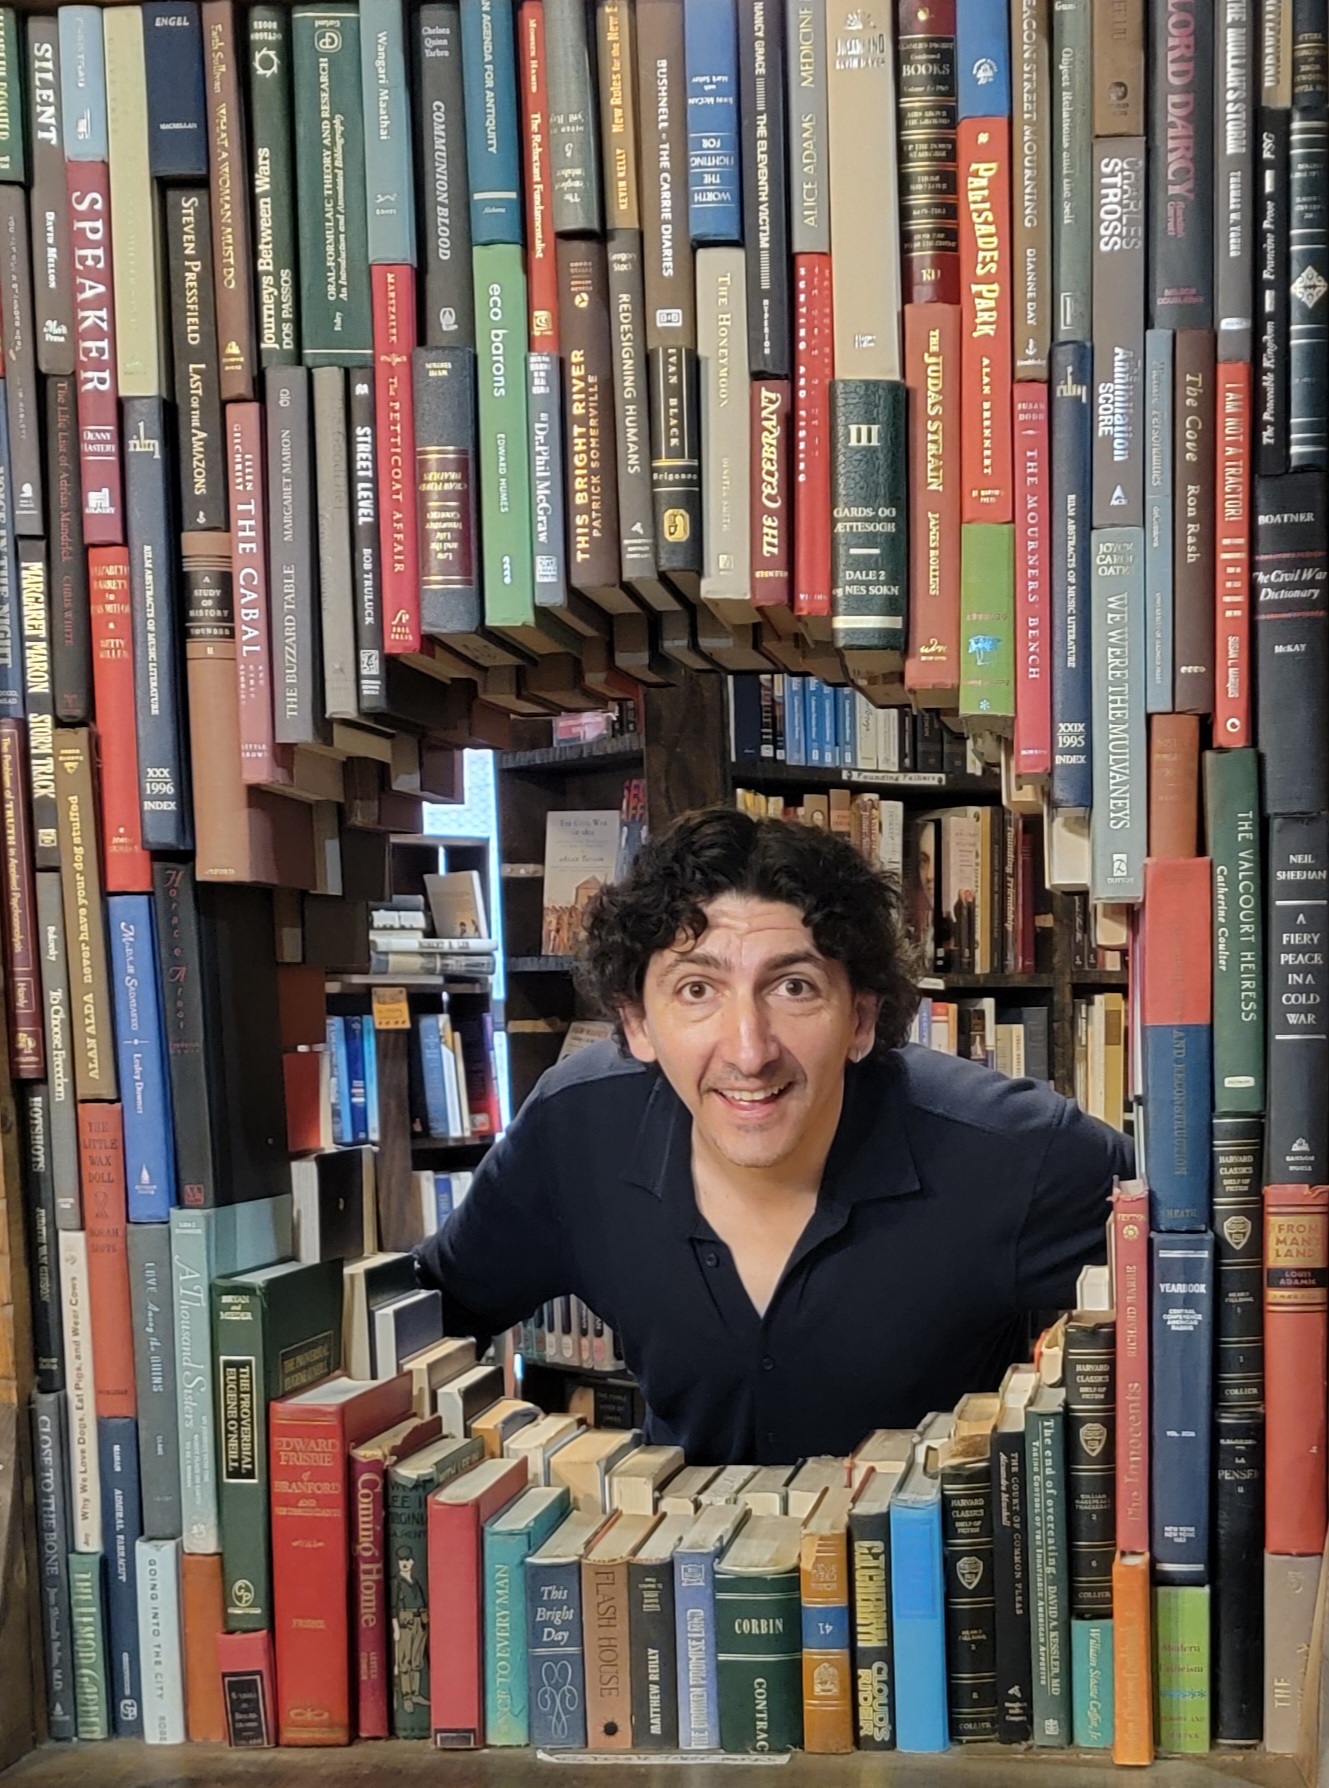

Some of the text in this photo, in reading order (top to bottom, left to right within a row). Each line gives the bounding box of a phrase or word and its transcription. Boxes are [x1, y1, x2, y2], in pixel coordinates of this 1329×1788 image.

[155, 17, 189, 27] ENGEL
[753, 1, 766, 75] NANCY GRACE
[33, 42, 58, 146] SILENT
[375, 31, 391, 140] Wangari Maathai
[902, 63, 951, 77] BOOKS
[1167, 0, 1195, 200] LORD DARCY
[215, 103, 236, 289] WHAT A WOMAN MUST DO
[431, 100, 452, 261] COMMUNION BLOOD
[531, 112, 545, 259] The Reluctant Fundamentalist
[655, 59, 674, 277] BUSHNELL THE CARRIE DIARIES
[694, 192, 731, 204] WORTH
[703, 174, 721, 184] THE
[756, 113, 771, 248] THE ELEVENTH VICTIM
[801, 114, 818, 228] ALICE ADAMS
[1099, 157, 1121, 252] STROSS
[181, 196, 201, 345] STEVEN PRESSFIELD
[254, 147, 279, 350] Journeys Between Wars
[966, 162, 1000, 338] PALISADES PARK
[1026, 248, 1038, 326] DIANNE DAY
[71, 191, 110, 393] SPEAKER
[280, 269, 293, 349] DOS PASSOS
[488, 284, 509, 398] eco barons
[617, 293, 641, 474] REDESIGNING HUMANS
[1098, 383, 1114, 437] SCORE
[1185, 372, 1202, 462] The Cove
[1224, 392, 1243, 413] AM
[570, 349, 592, 563] THIS BRIGHT RIVER
[1225, 417, 1243, 443] NOT
[1225, 446, 1243, 457] A
[281, 429, 294, 542] MARGARET MARON
[357, 426, 374, 525] STREET LEVEL
[496, 433, 509, 513] EDWARD HUMES
[1225, 459, 1243, 522] TRACTOR!
[1186, 484, 1202, 564] Ron Rash
[1257, 512, 1315, 525] BOATNER
[236, 499, 261, 658] THE CABAL
[362, 547, 374, 625] BOB TRULUCK
[1260, 587, 1320, 601] Dictionary
[21, 562, 49, 693] MARGARET MARON
[282, 564, 298, 719] THE BUZZARD TABLE
[1056, 736, 1086, 748] 1995
[1058, 723, 1086, 733] XXIX
[1107, 592, 1131, 829] WE WERE THE MULVANEYS
[28, 713, 56, 799] STORM TRACK
[145, 782, 175, 795] 1996
[146, 767, 169, 778] XXX
[1055, 755, 1087, 764] INDEX
[144, 801, 177, 811] INDEX
[1276, 870, 1326, 881] SHEEHAN
[1289, 854, 1316, 864] NEIL
[1216, 865, 1229, 972] Catherine Coulter
[1237, 811, 1257, 1022] THE VALCOURT HEIRESS
[1282, 934, 1319, 945] FIERY
[1280, 953, 1323, 965] PEACE
[1288, 974, 1316, 985] IN A
[1282, 994, 1320, 1005] COLD
[1286, 1014, 1317, 1025] WAR
[1126, 1265, 1137, 1357] RICHARD BARRE
[1160, 1283, 1206, 1294] YEARBOOK
[176, 1255, 206, 1428] A Thousand Sisters
[226, 1367, 239, 1471] EUGENE O'NEILL
[239, 1365, 252, 1473] THE PROVERBIAL
[1224, 1388, 1258, 1396] COLLIER
[274, 1438, 339, 1452] EDWARD
[37, 1415, 59, 1576] CLOSE TO THE BONE
[354, 1471, 382, 1628] Coming Home
[147, 1558, 164, 1700] GOING INTO THE CITY
[494, 1563, 511, 1686] TO EVERY MAN
[536, 1605, 575, 1625] Bright
[540, 1585, 568, 1601] This
[734, 1618, 783, 1635] CORBIN
[542, 1627, 569, 1645] Day
[595, 1571, 619, 1698] FLASH HOUSE
[858, 1668, 873, 1736] RIDER
[872, 1661, 891, 1742] CLOUD'S
